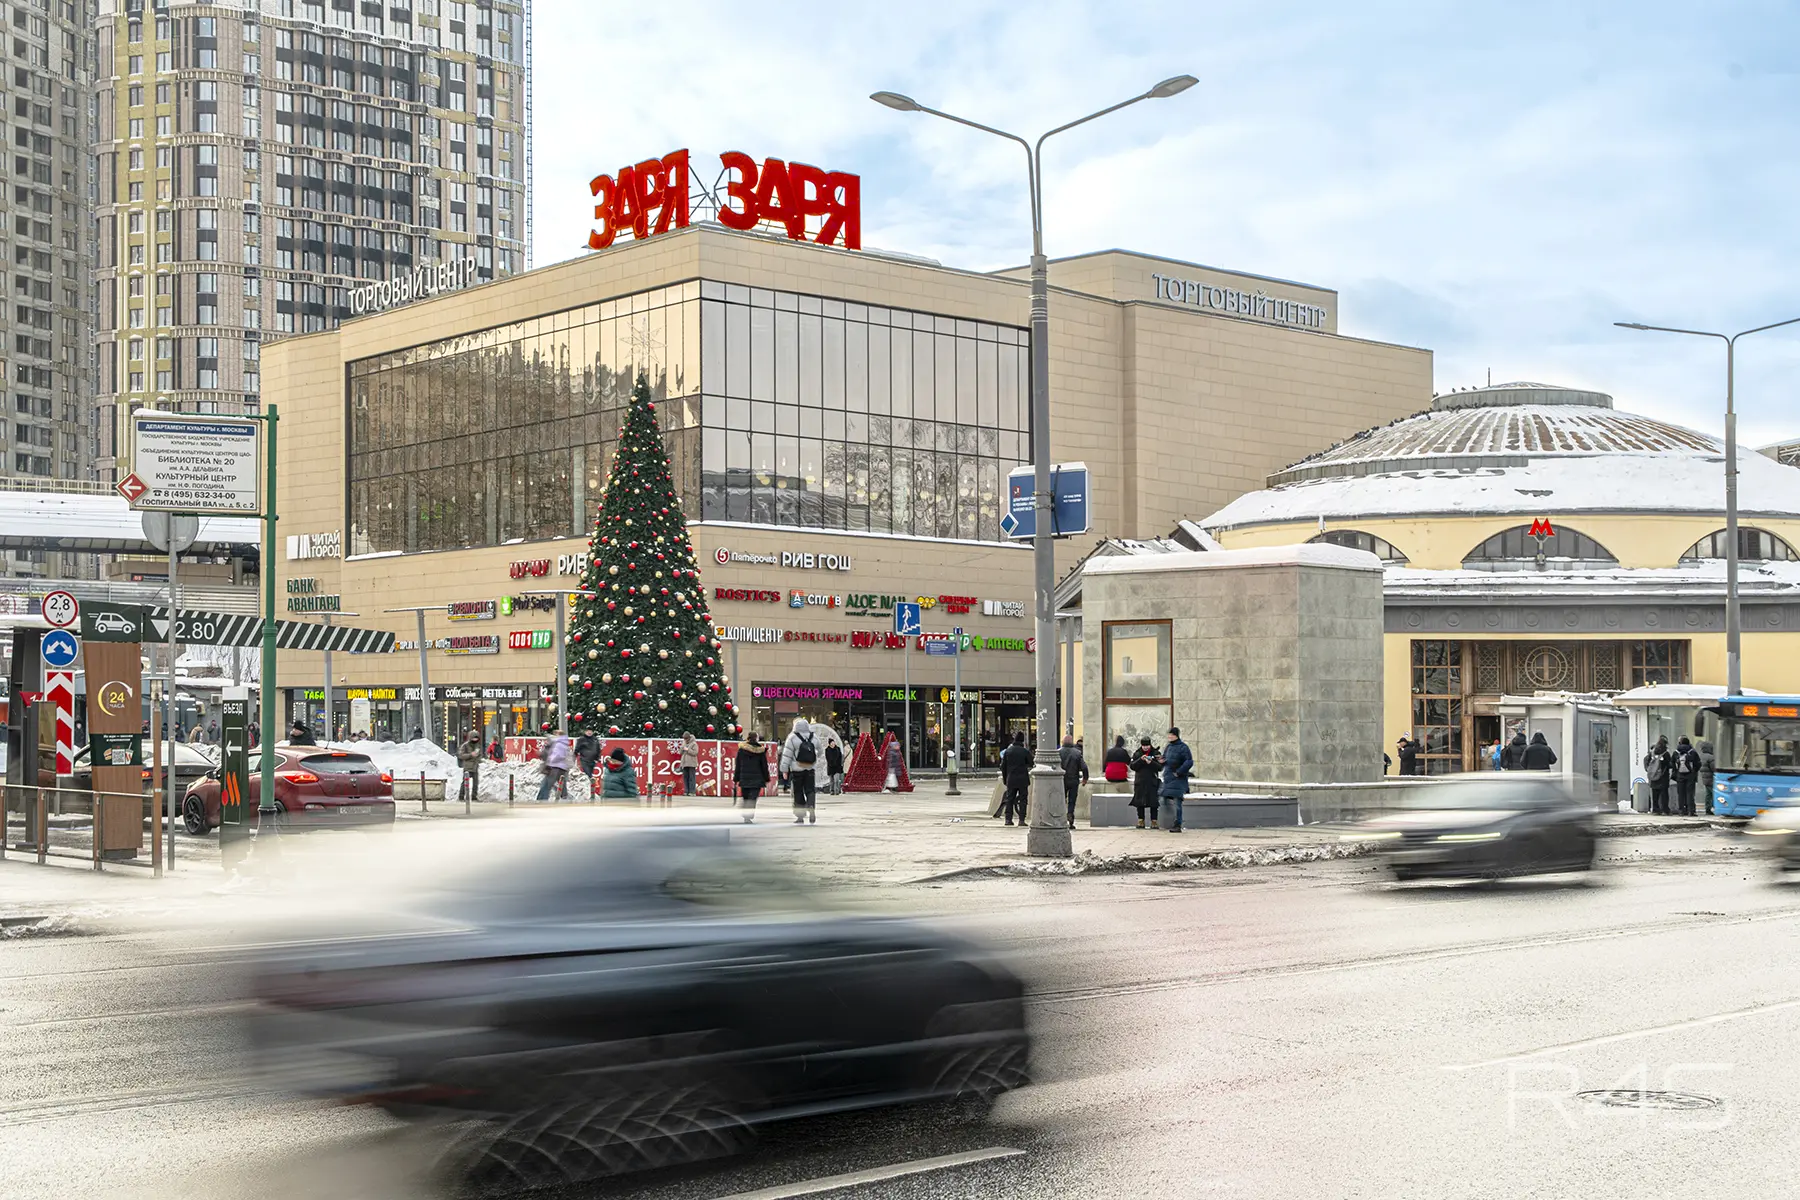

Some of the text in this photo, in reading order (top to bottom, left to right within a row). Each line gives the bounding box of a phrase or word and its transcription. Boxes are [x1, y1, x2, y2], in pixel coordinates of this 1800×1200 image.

[589, 148, 689, 250] ЗАРЯ
[717, 150, 861, 250] ЗАРЯ
[347, 255, 477, 315] ТОРГОВЫЙ ЦЕНТР
[1152, 273, 1328, 328] ТОРГОВЫЙ ЦЕНТР
[145, 423, 186, 431] ДЕПАРТАМЕНТ
[157, 455, 211, 465] БИБЛИОТЕКА
[224, 458, 235, 466] 20
[155, 472, 237, 483] КУЛЬТУРНЫЙ ЦЕНТР
[163, 490, 236, 500] 8 (495) 632-34-00
[141, 498, 201, 507] ГОСПИТАЛЬНЫЙ
[202, 500, 218, 508] ВАЛ
[311, 529, 341, 546] ЧИТАЙ
[311, 544, 341, 558] ГОРОД
[731, 551, 778, 564] Пятёрочка
[781, 551, 851, 571] РИВ ГОШ
[286, 577, 316, 593] БАНК
[715, 588, 781, 603] ROSTIC'S
[845, 594, 878, 609] ALOE
[50, 597, 71, 611] 2,8
[286, 594, 341, 612] АВАНГАРД
[453, 601, 488, 615] РЕМОНТ
[1003, 601, 1025, 609] ЧИТАЙ
[1002, 609, 1025, 617] ГОРОД
[175, 621, 215, 640] 2.80
[727, 626, 783, 643] КОПИЦЕНТР
[451, 637, 469, 649] ДОМ
[469, 636, 491, 648] БЫТА
[987, 637, 1025, 651] АПТЕКА
[109, 692, 125, 704] 24
[303, 689, 326, 700] ТАБА
[763, 687, 820, 700] ЦВЕТОЧНАЯ
[949, 690, 969, 701] FRNCH
[223, 703, 244, 715] ВЪЕЗД
[657, 760, 713, 776] 206
